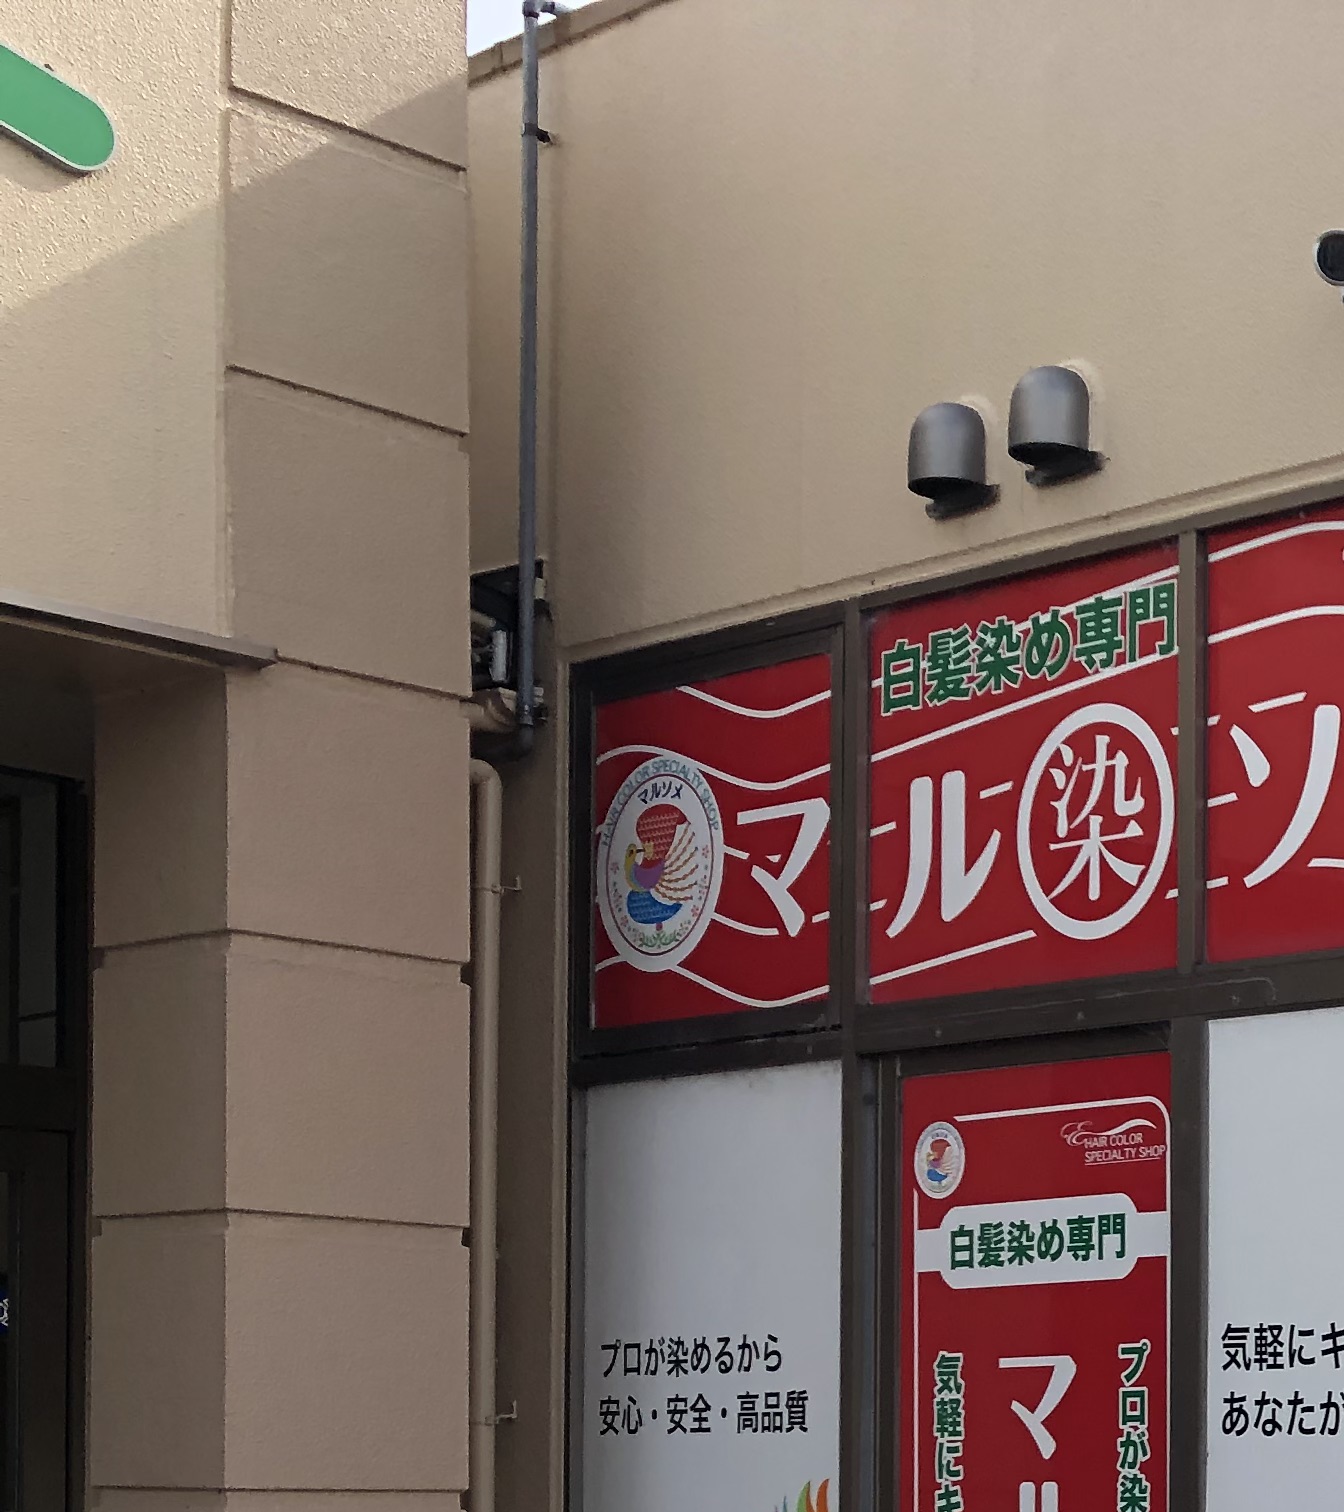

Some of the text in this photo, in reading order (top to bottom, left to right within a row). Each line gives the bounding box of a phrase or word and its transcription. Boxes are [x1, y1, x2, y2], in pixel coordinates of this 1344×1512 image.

[878, 582, 1177, 715] 白髪染め専門
[616, 765, 649, 805] COLOR
[651, 758, 702, 788] SPECIALTY
[700, 788, 720, 831] SHOP
[637, 780, 684, 805] マルソメ
[1084, 1133, 1143, 1148] HAIR COLOR
[1084, 1145, 1166, 1163] SPECIALTY SHOP
[950, 1212, 1127, 1270] 白髪染め専門
[600, 1334, 782, 1377] プロが染めるから
[599, 1389, 809, 1435] 安心・安全・高品質
